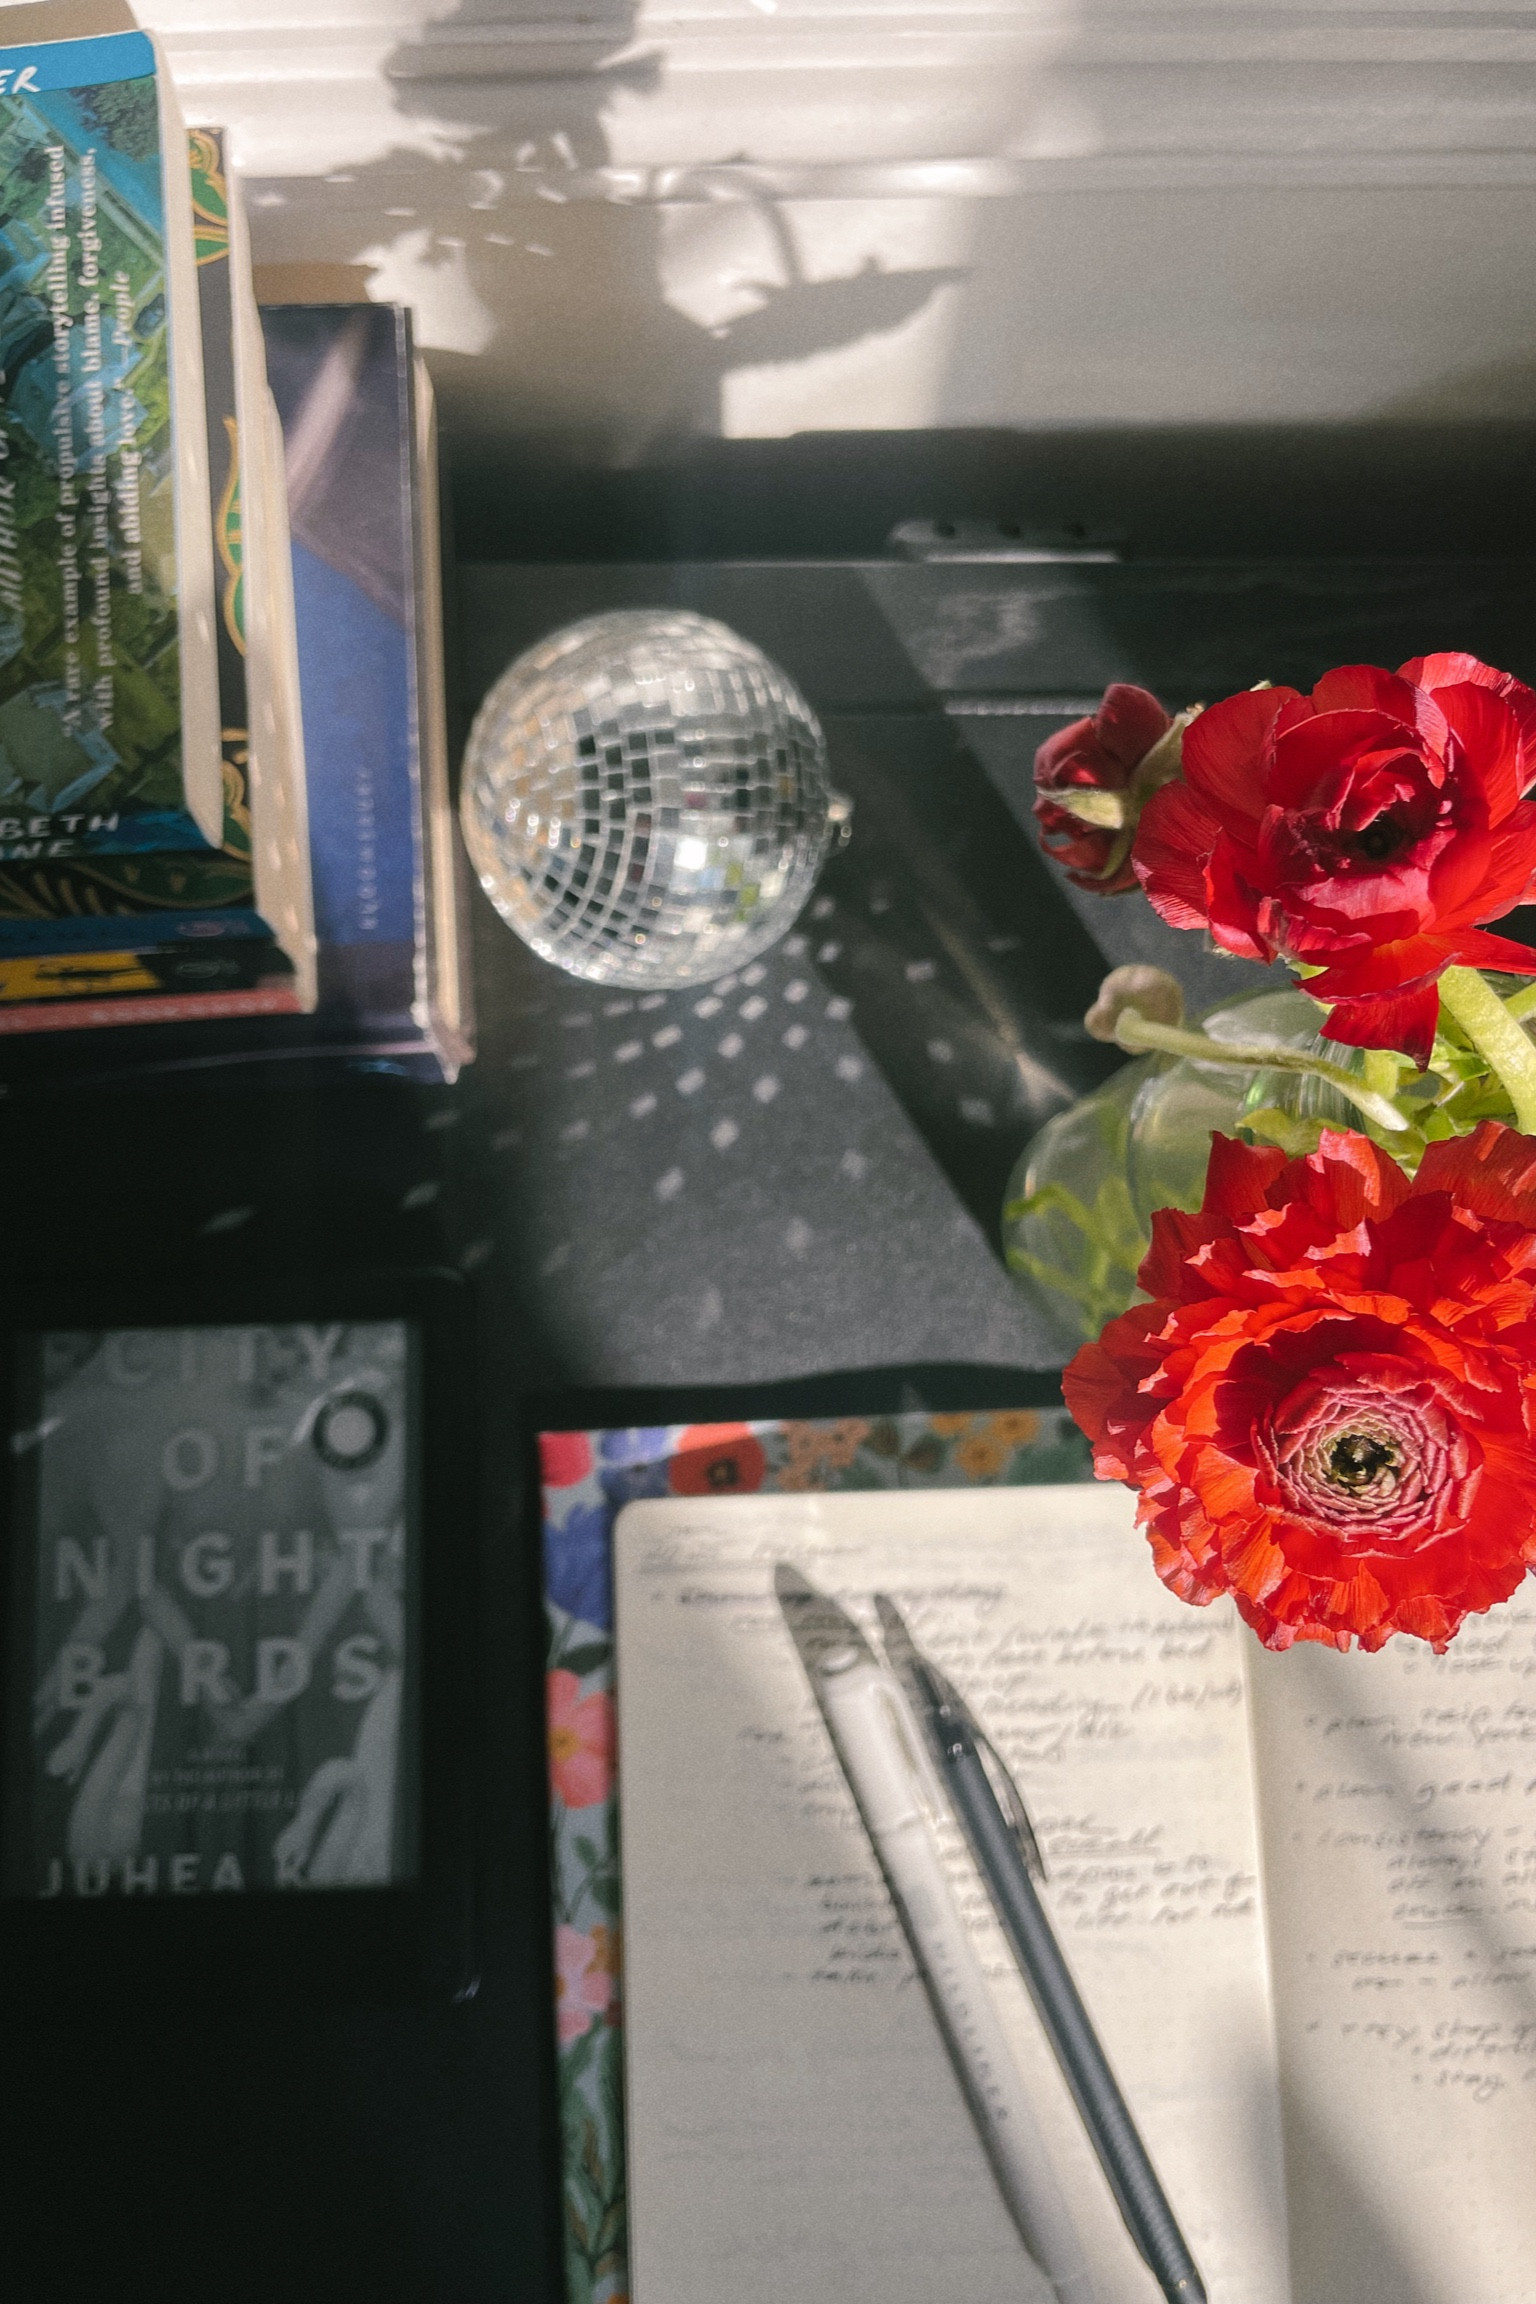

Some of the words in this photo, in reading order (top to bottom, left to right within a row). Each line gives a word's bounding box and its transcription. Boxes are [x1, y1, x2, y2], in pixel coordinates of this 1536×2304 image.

[44, 144, 67, 230] infused
[77, 147, 102, 288] forgiveness,
[47, 234, 74, 375] storytelling
[80, 292, 101, 374] blame,
[54, 379, 79, 507] propulsive
[85, 380, 105, 449] about
[56, 511, 76, 538] of
[87, 455, 112, 548] insights
[115, 450, 142, 543] abiding
[57, 544, 82, 644] example
[120, 548, 143, 596] and
[90, 555, 117, 667] profound
[65, 652, 81, 702] rare
[94, 674, 114, 730] with
[106, 1325, 344, 1386] CITY
[163, 1427, 289, 1490] OF
[56, 1528, 389, 1600] NIGHT
[40, 1851, 246, 1898] JUHEA
